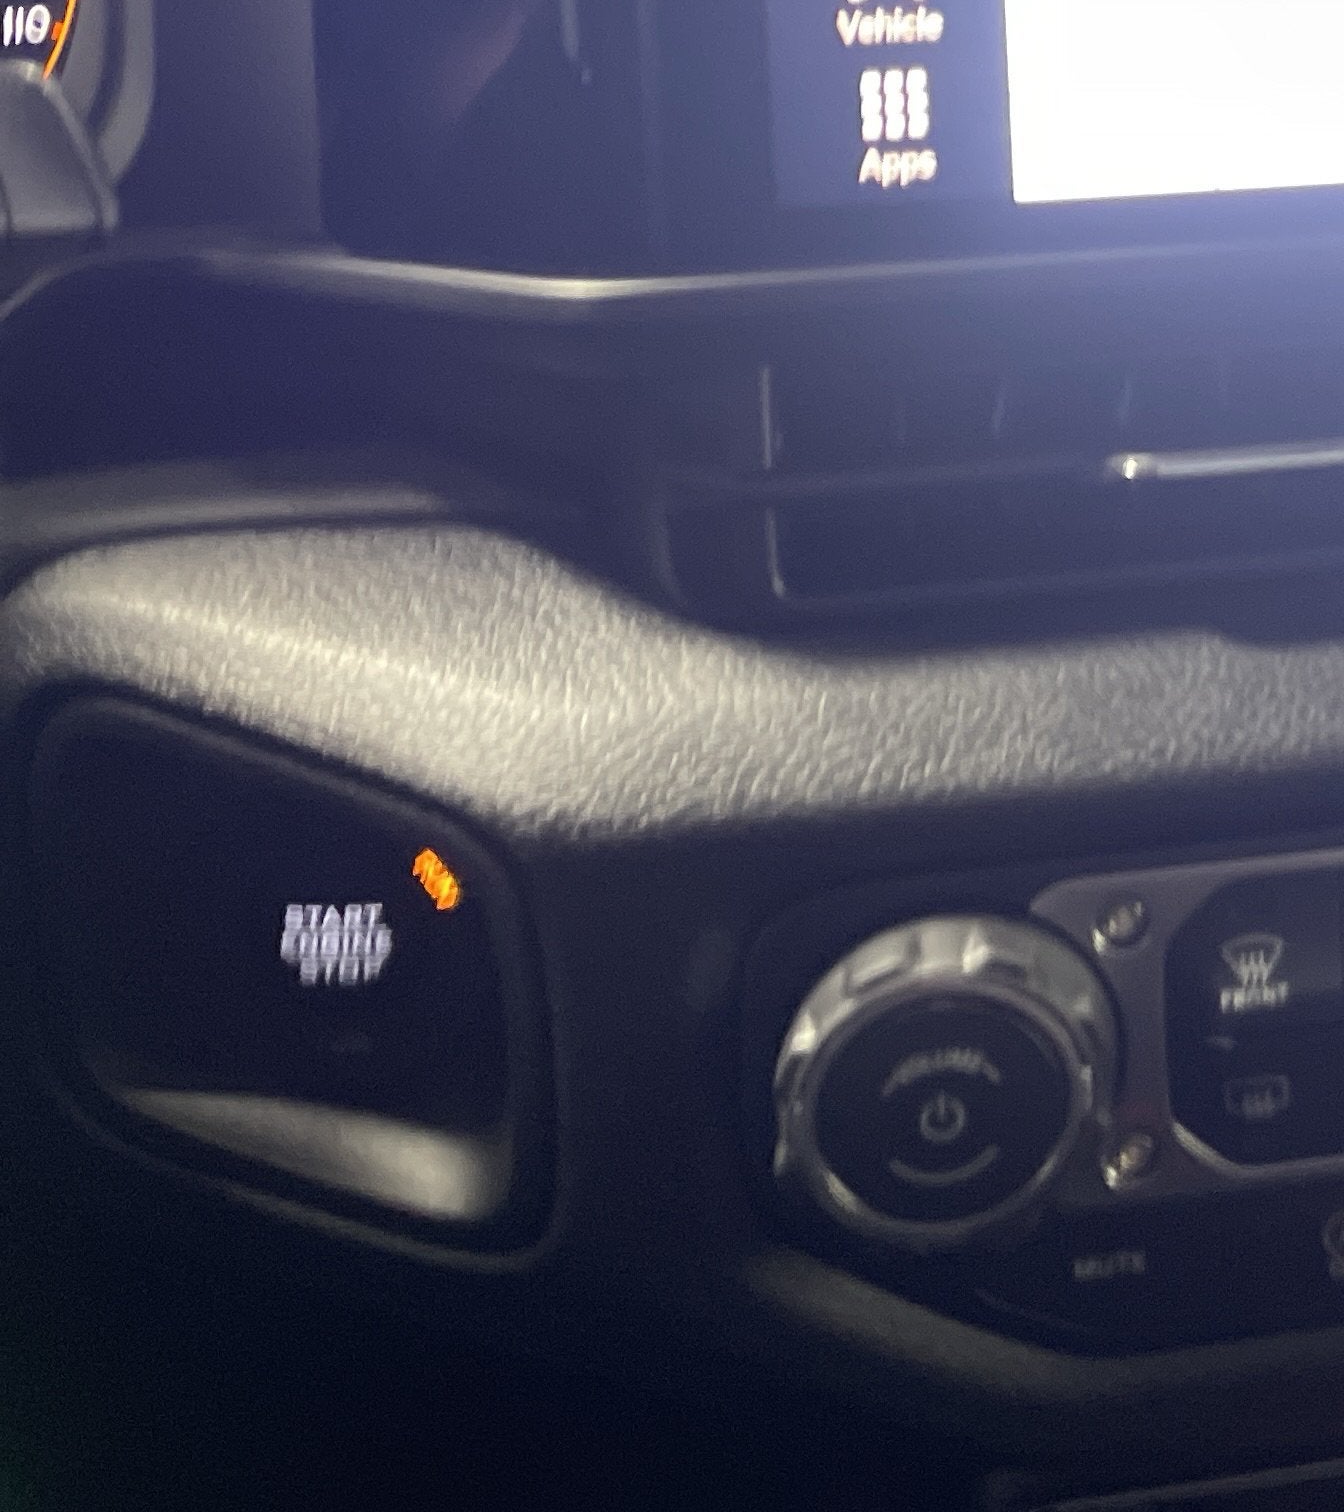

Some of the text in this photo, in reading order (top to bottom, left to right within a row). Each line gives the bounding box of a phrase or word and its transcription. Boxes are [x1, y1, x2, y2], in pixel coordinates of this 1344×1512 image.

[2, 4, 51, 48] 110
[836, 5, 945, 47] Vehicle
[858, 147, 939, 188] Apps
[285, 903, 384, 930] START
